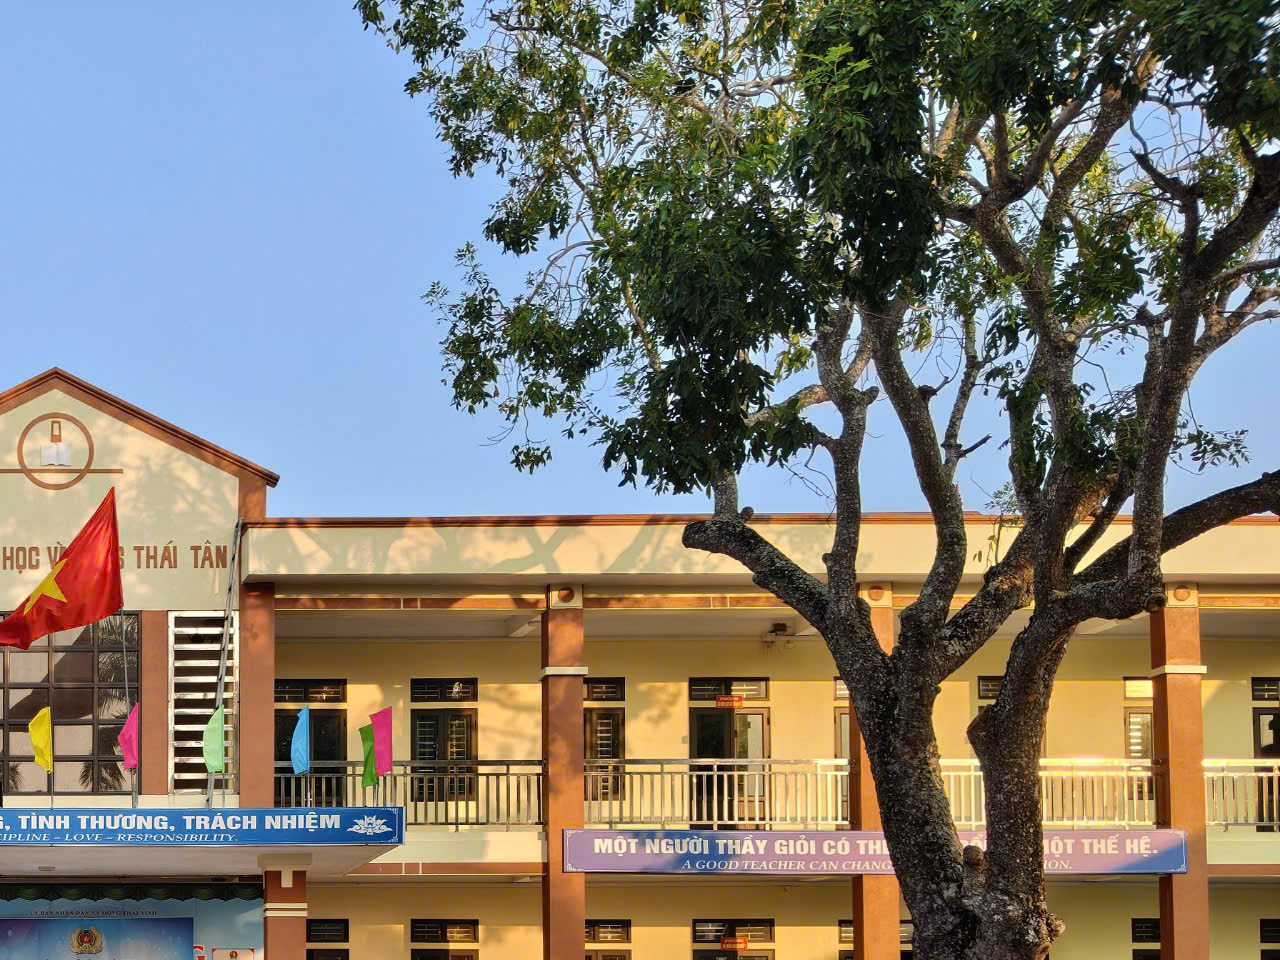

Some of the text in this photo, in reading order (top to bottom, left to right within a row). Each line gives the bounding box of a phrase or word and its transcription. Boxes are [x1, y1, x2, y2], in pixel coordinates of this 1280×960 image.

[3, 546, 40, 574] HỌC
[133, 540, 178, 569] THÁI
[190, 539, 227, 569] TÂN
[20, 810, 70, 830] TÌNH
[77, 813, 175, 832] THƯƠNG,
[183, 812, 257, 830] TRÁCH
[264, 812, 340, 832] NHIỆM
[64, 834, 103, 842] LOVE
[117, 834, 238, 842] RESPONSIBILITY.
[594, 837, 638, 857] MỘT
[645, 835, 709, 854] NGƯỜI
[715, 834, 767, 855] THẦY
[774, 835, 816, 855] GIỎI
[823, 837, 850, 855] CÓ
[1081, 834, 1119, 854] THẾ
[1125, 836, 1157, 857] HỆ.
[682, 860, 894, 870] A GOOD TEACHER CAN CHANG
